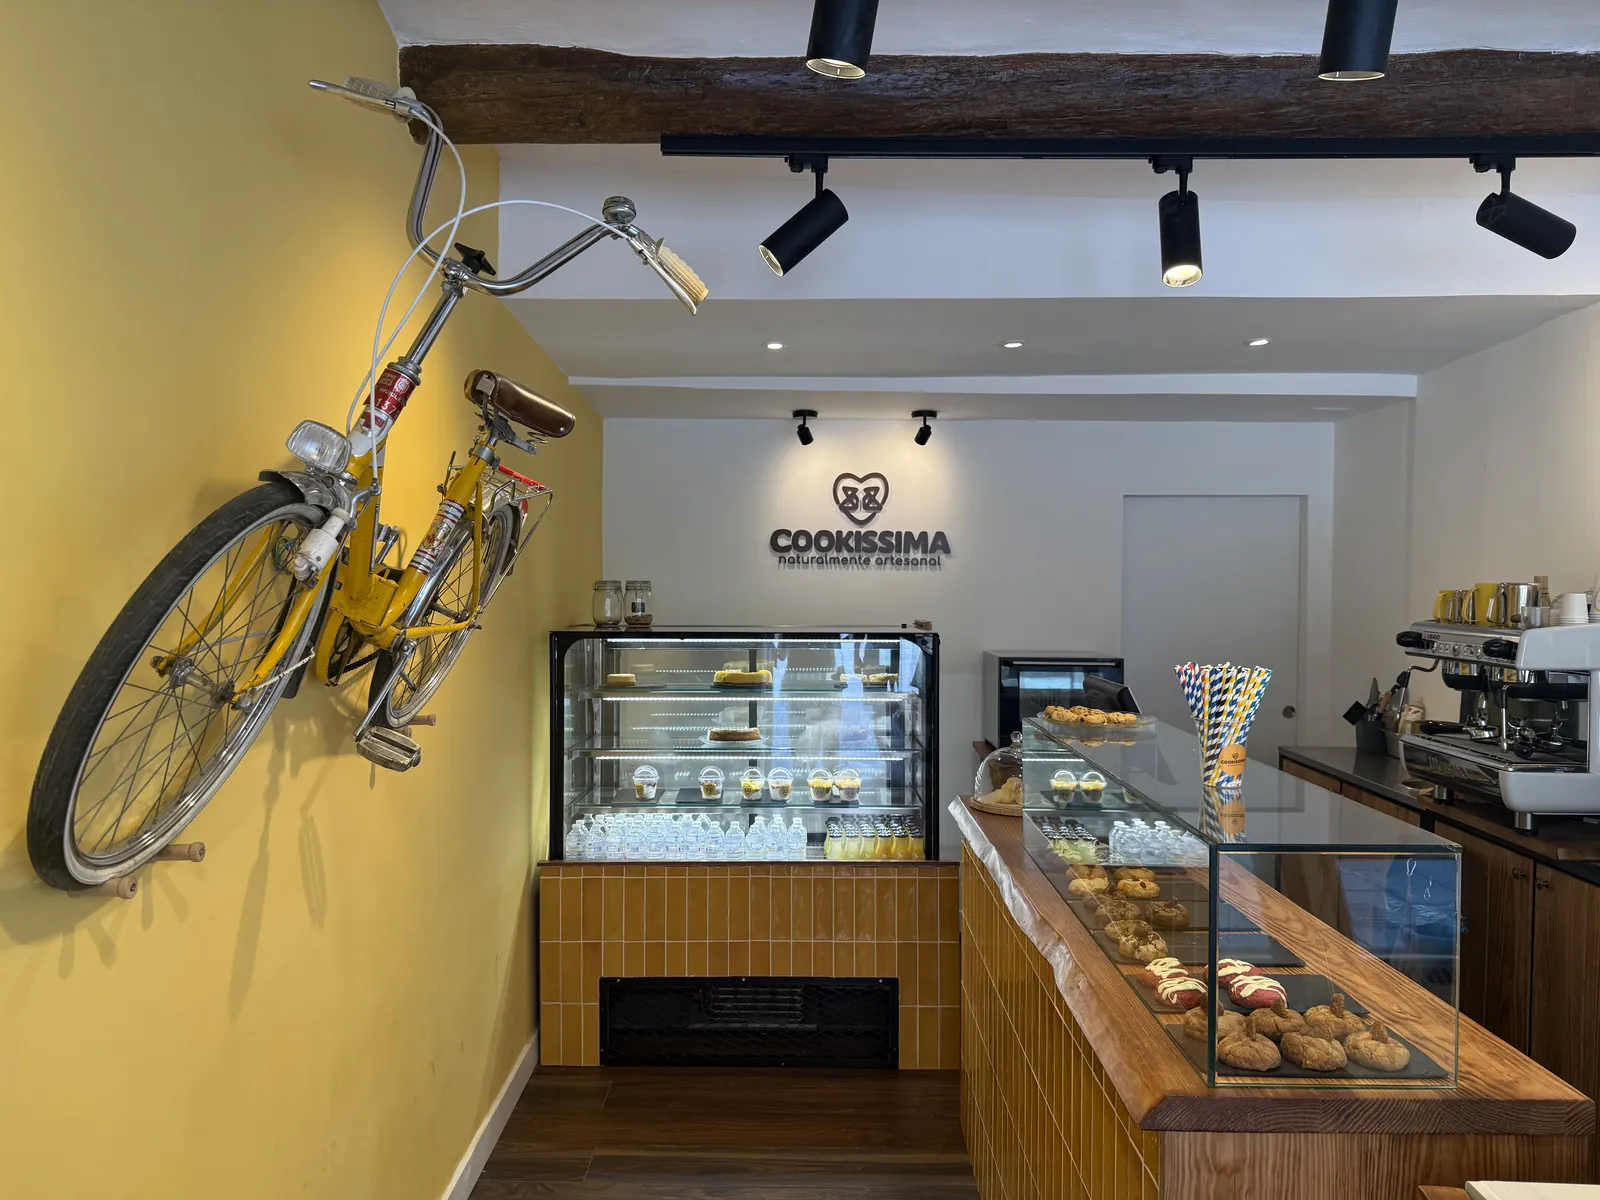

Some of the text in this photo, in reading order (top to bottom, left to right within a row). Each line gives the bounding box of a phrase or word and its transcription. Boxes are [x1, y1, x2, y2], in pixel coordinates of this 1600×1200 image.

[770, 528, 951, 554] COOKISSIMA
[778, 554, 941, 567] naturalmente artesanal
